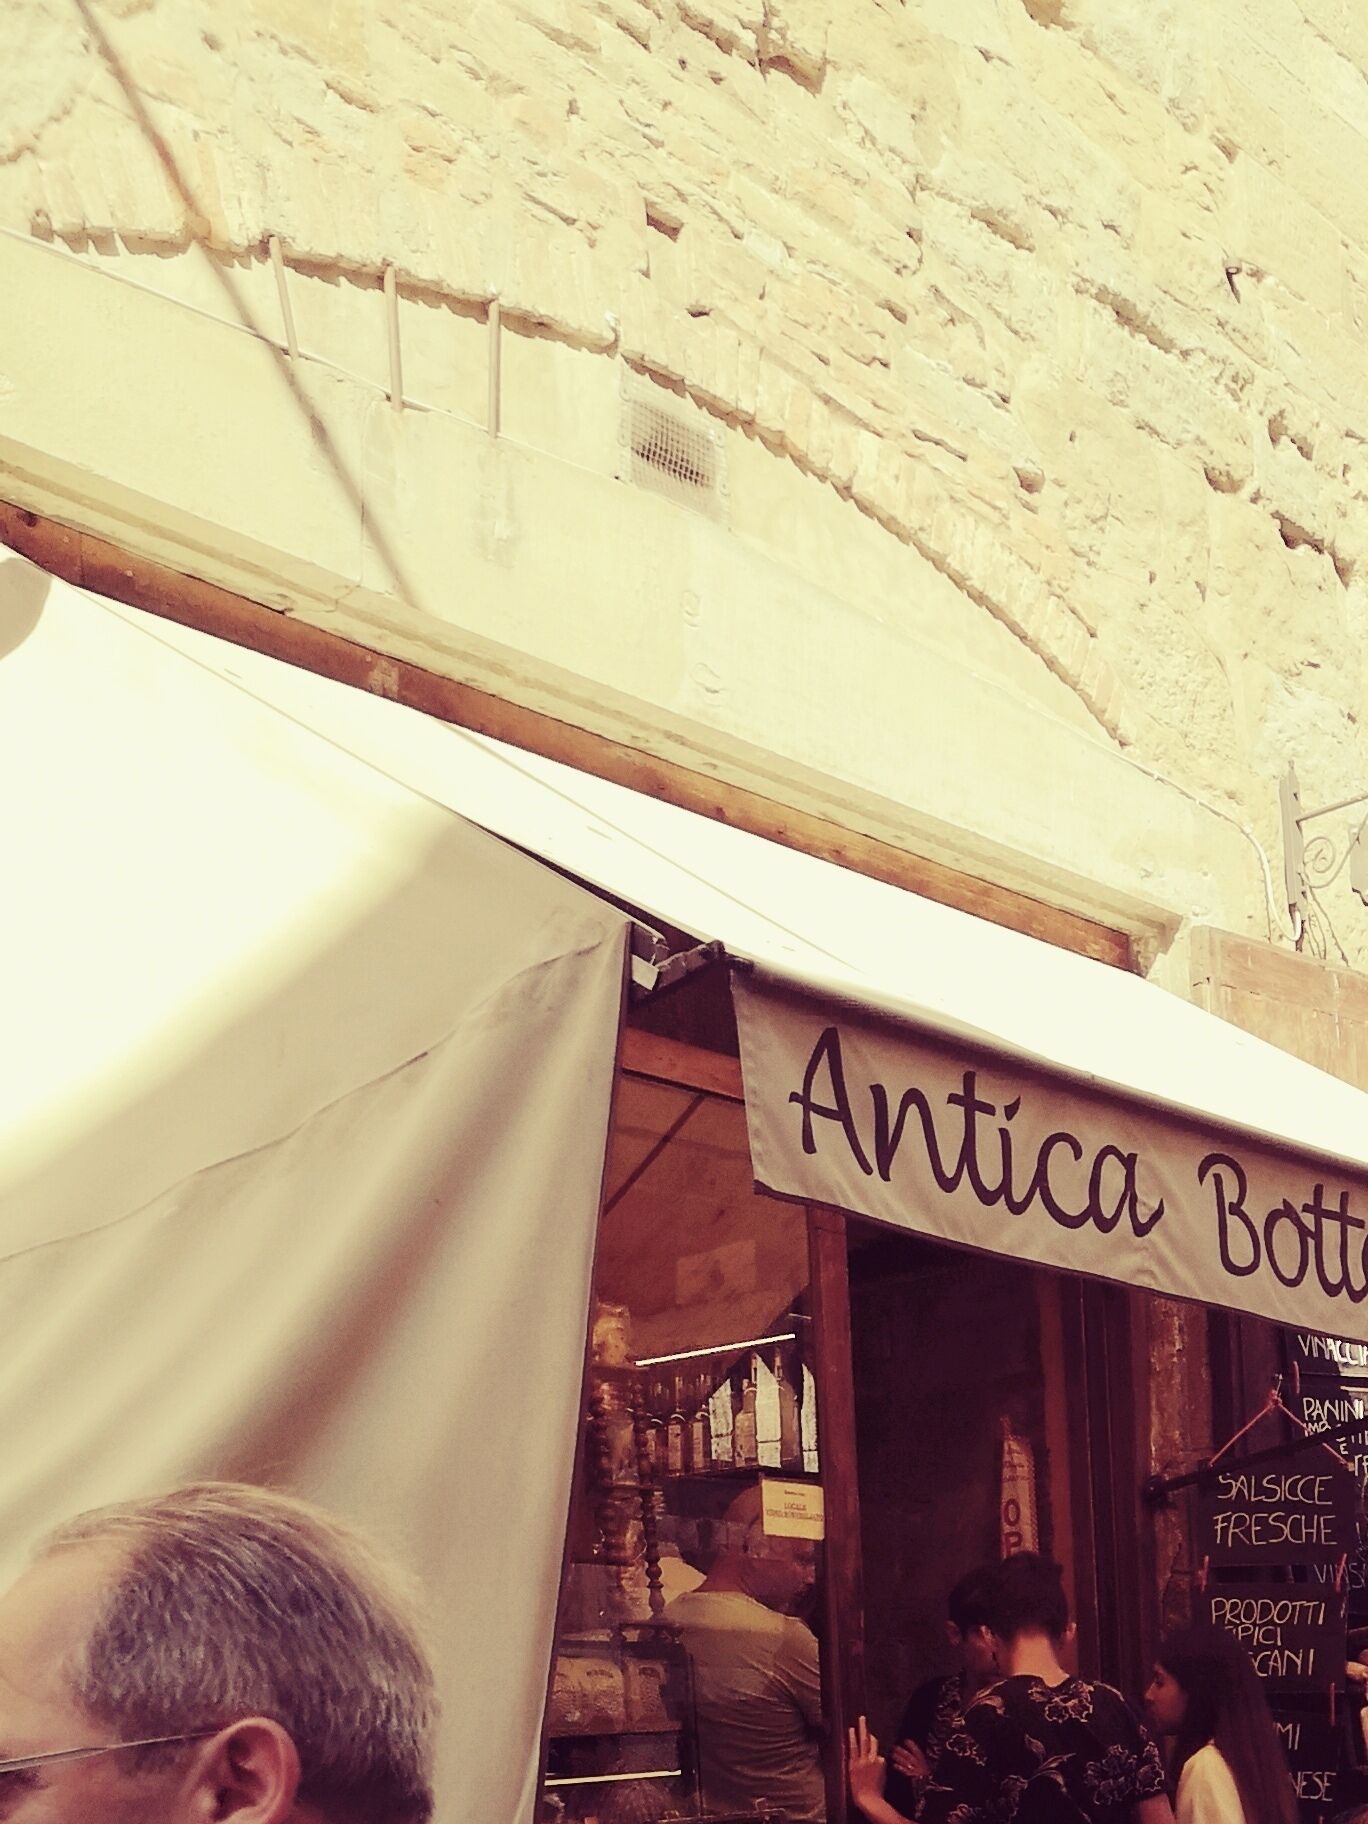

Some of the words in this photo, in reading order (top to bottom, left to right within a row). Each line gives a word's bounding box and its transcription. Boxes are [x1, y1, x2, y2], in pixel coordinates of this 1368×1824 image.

[789, 1026, 1166, 1239] Antica
[1303, 1397, 1364, 1423] PANINI
[1217, 1473, 1333, 1505] SALSICCE
[1213, 1512, 1338, 1548] FRESCHE
[1211, 1597, 1325, 1625] PRODOTTI
